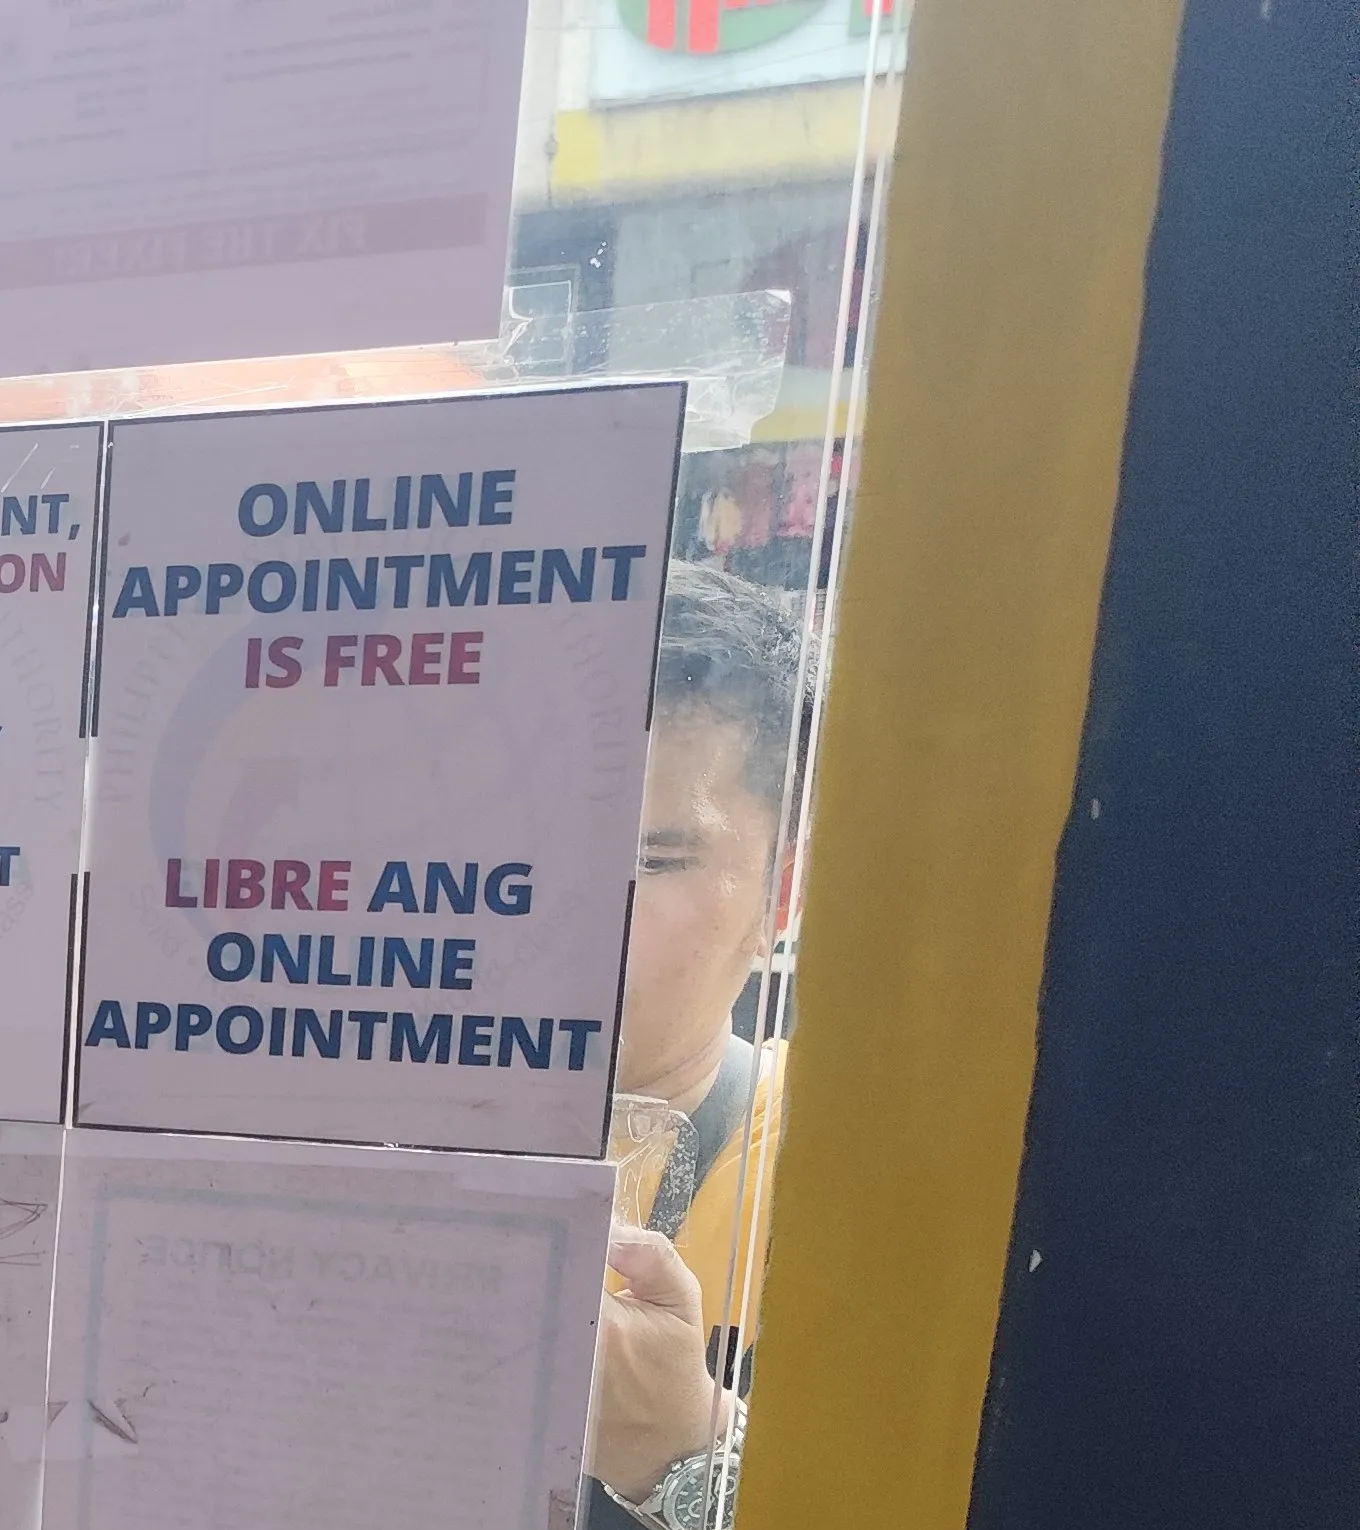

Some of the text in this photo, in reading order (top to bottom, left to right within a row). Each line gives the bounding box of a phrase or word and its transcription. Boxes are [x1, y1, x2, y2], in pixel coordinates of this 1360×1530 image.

[238, 469, 517, 537] ONLINE
[112, 545, 647, 619] APPOINTMENT
[245, 631, 484, 690] IS FREE
[165, 858, 533, 916] LIBRE ANG
[206, 931, 477, 990] ONLINE
[84, 999, 602, 1072] APPOINTMENT
